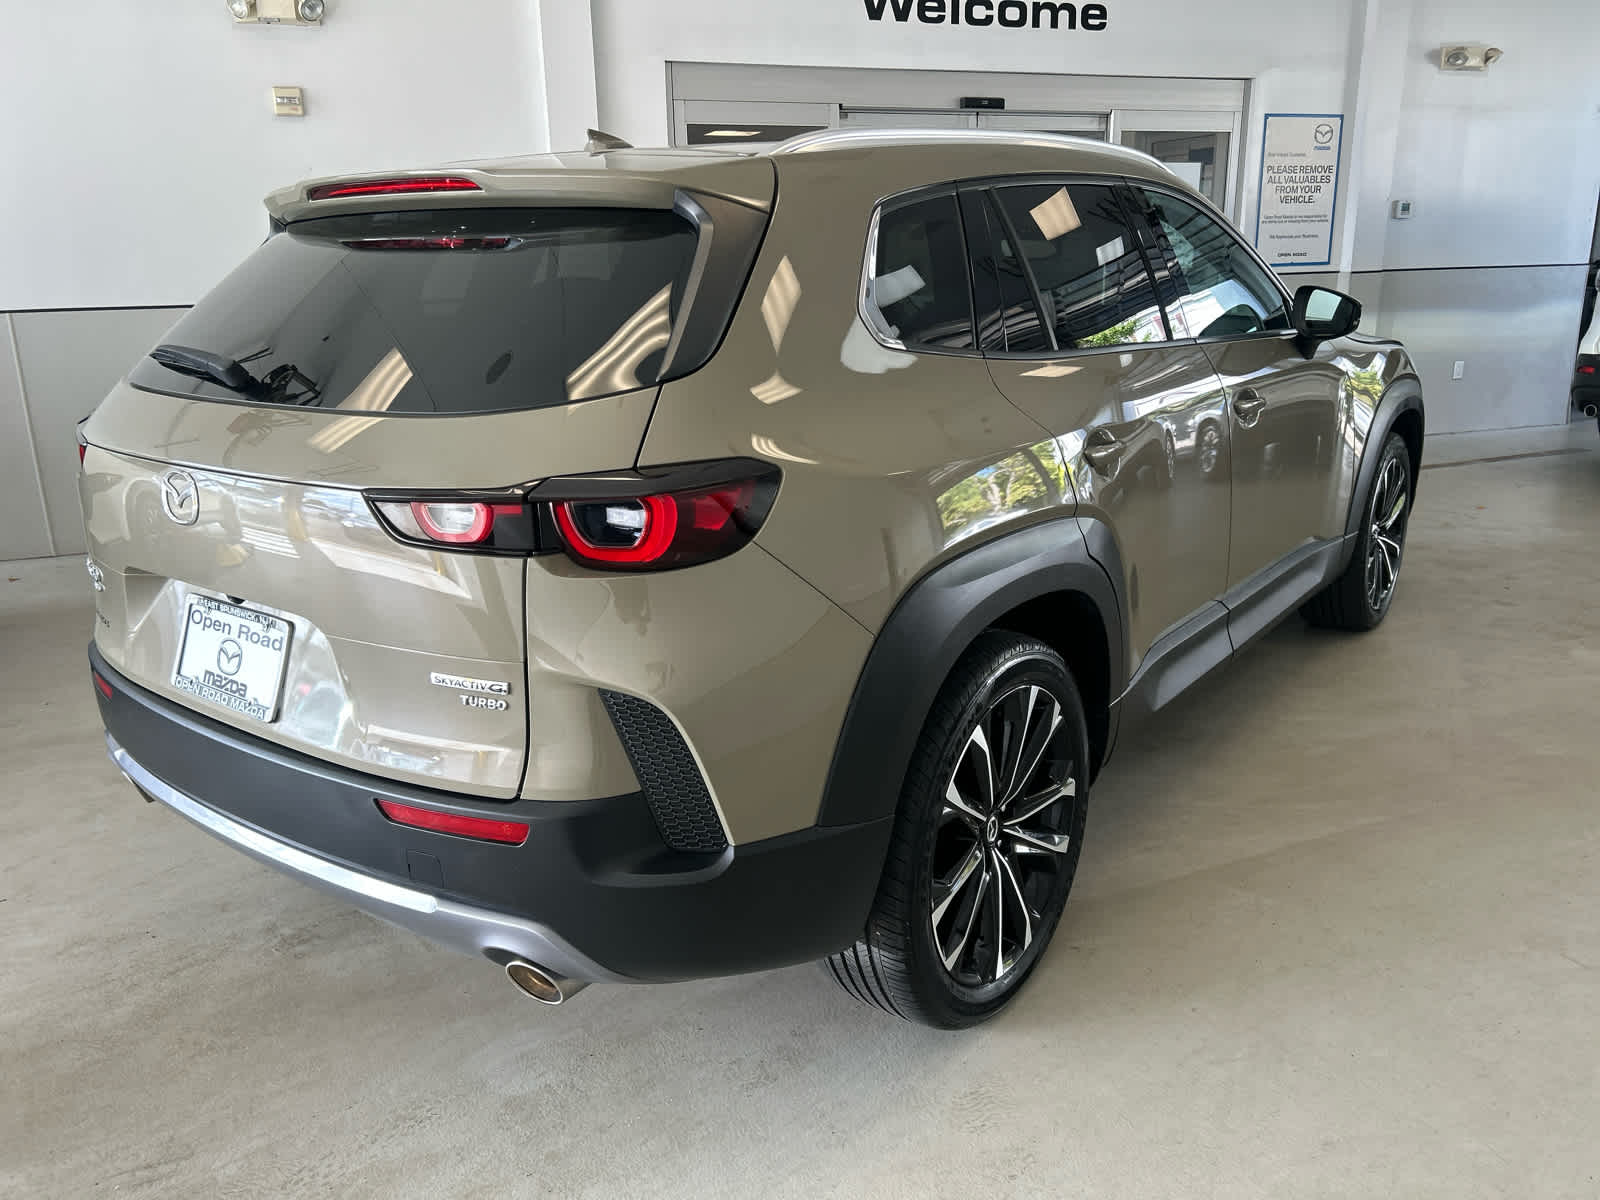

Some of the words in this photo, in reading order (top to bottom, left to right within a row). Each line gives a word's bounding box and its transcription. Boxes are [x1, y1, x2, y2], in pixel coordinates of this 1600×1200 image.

[863, 0, 1108, 31] Welcome
[1267, 165, 1298, 174] PLEASE
[1299, 165, 1334, 174] REMOVE
[1267, 175, 1283, 184] ALL
[1284, 175, 1331, 184] VALUABLES
[1275, 185, 1298, 194] FROM
[1299, 185, 1322, 194] YOUR
[1280, 195, 1316, 204] VEHICLE.
[191, 609, 232, 635] Open
[237, 624, 283, 651] Road
[203, 670, 248, 697] mazda
[201, 685, 229, 705] ROAD
[230, 695, 265, 720] MAZDA
[460, 695, 509, 711] TURBO
